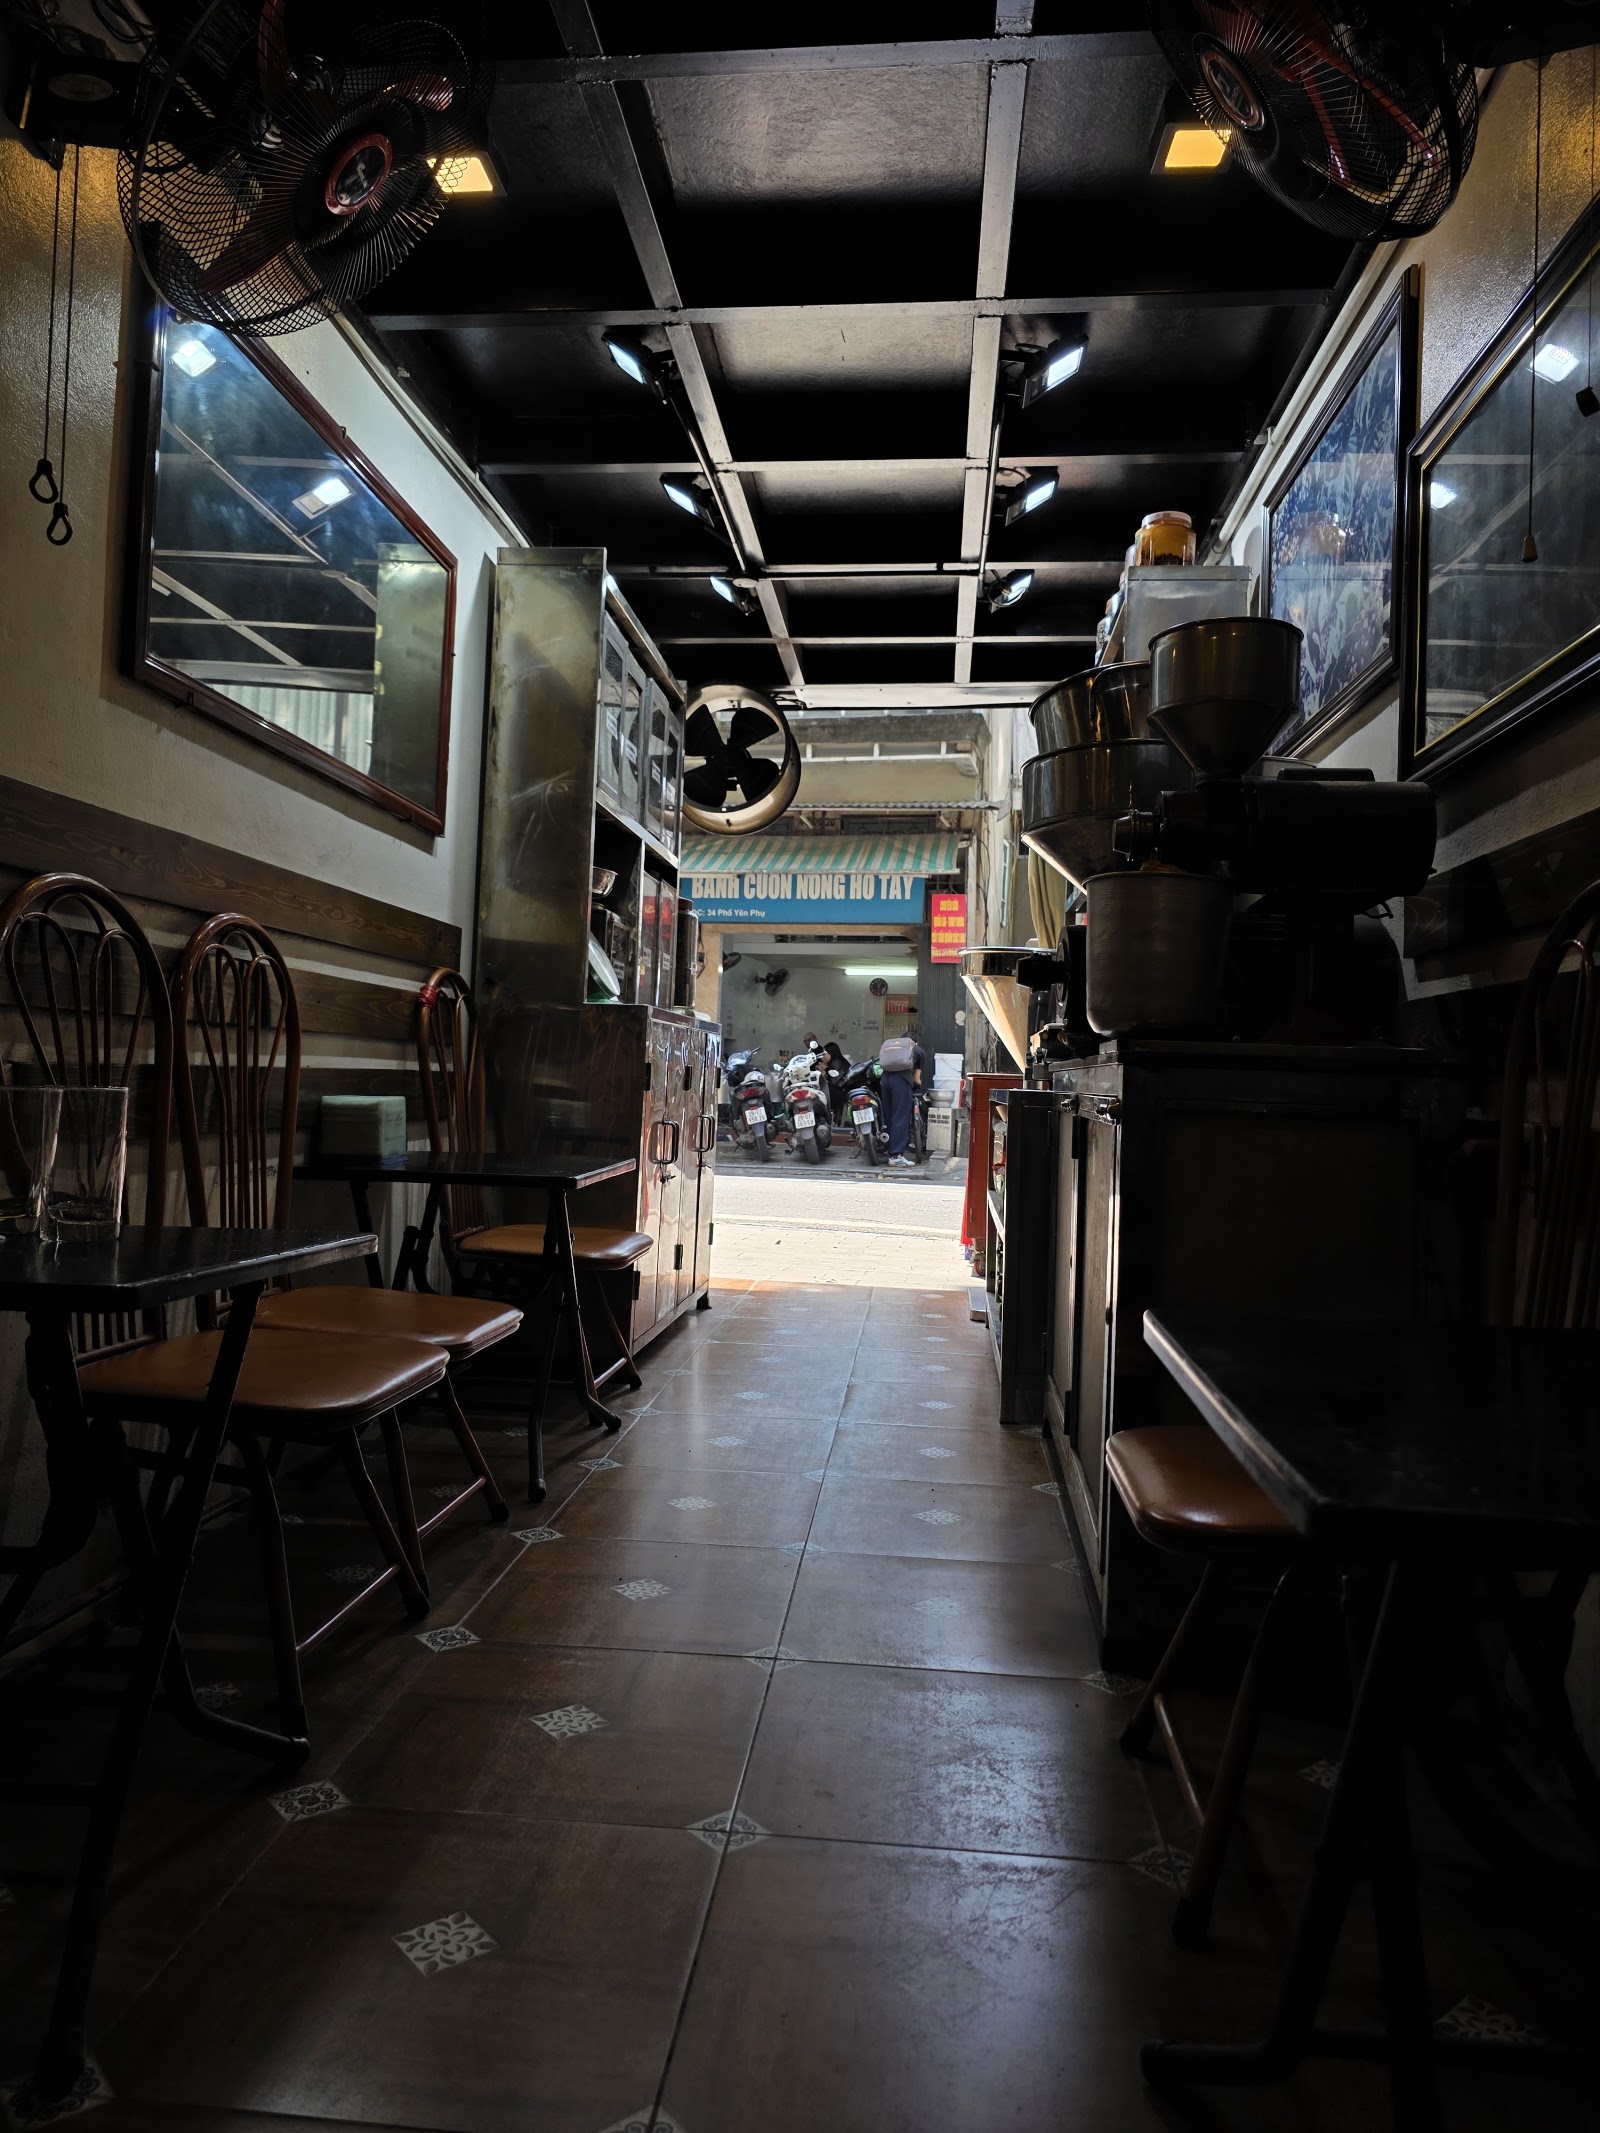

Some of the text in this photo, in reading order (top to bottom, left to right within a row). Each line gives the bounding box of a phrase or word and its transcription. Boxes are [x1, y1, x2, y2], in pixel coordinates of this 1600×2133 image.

[706, 908, 716, 917] 34
[717, 907, 733, 917] Phố
[734, 908, 749, 917] Yên
[749, 908, 766, 919] Phụ
